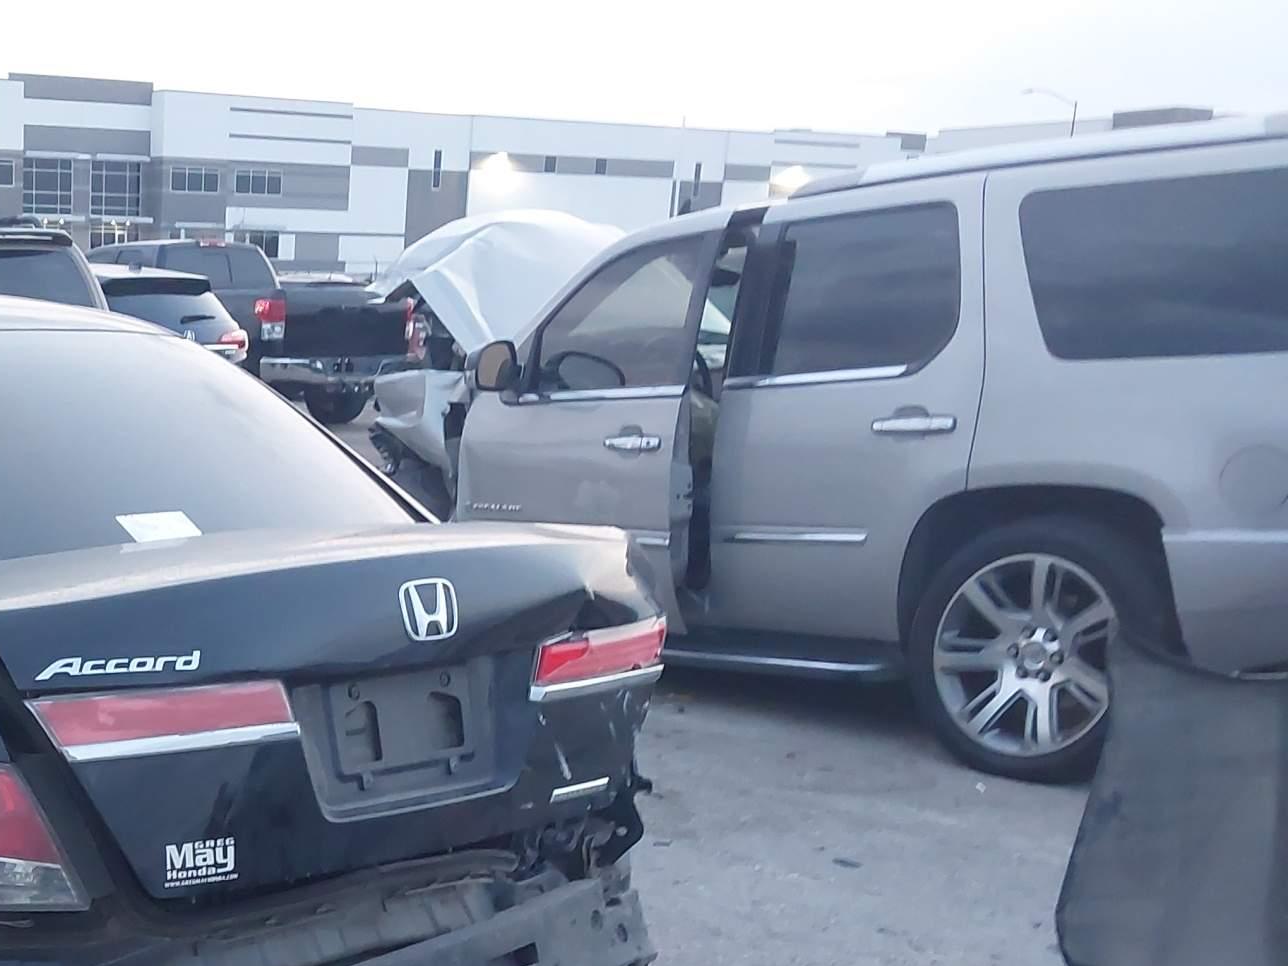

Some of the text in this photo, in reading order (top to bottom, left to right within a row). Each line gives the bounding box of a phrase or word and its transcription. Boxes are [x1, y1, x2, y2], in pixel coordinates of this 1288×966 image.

[34, 650, 201, 681] Accord
[165, 842, 235, 874] May
[166, 866, 217, 880] Honda
